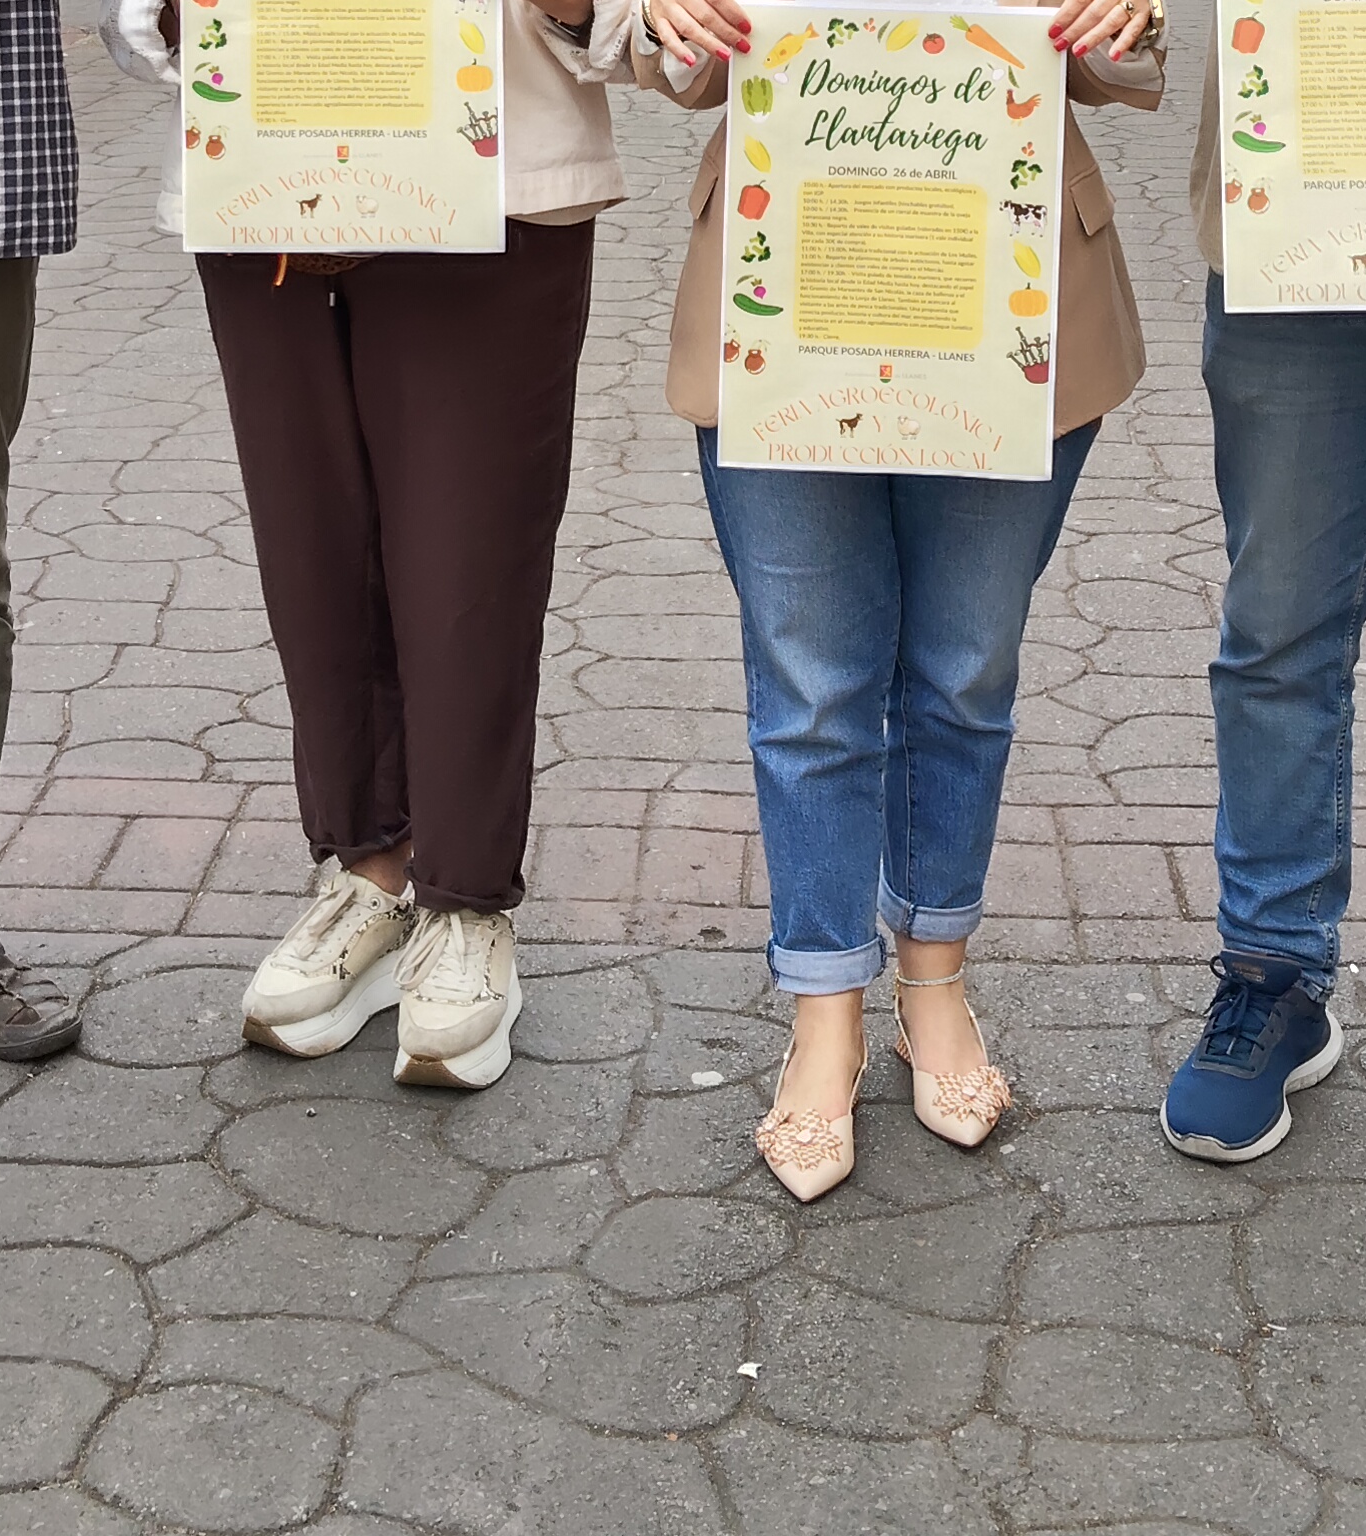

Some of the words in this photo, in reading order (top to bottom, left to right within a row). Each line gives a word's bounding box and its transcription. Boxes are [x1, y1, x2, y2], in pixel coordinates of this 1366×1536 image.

[799, 57, 946, 114] Domingos
[954, 66, 996, 104] de
[257, 129, 296, 139] PARQUE
[299, 128, 338, 137] POSADA
[340, 129, 384, 137] HERRERA
[392, 129, 427, 138] LLANES
[804, 105, 988, 167] Llantariega
[828, 165, 887, 177] DOMINGO
[893, 167, 906, 178] 26
[909, 168, 922, 178] de
[924, 169, 957, 180] ABRIL
[1303, 180, 1346, 191] PARQUE
[215, 183, 273, 226] FERIA
[798, 345, 838, 356] PARQUE
[841, 346, 882, 356] POSADA
[884, 348, 930, 358] HERRERA
[938, 351, 975, 362] LLANES
[751, 398, 812, 443] FERIA
